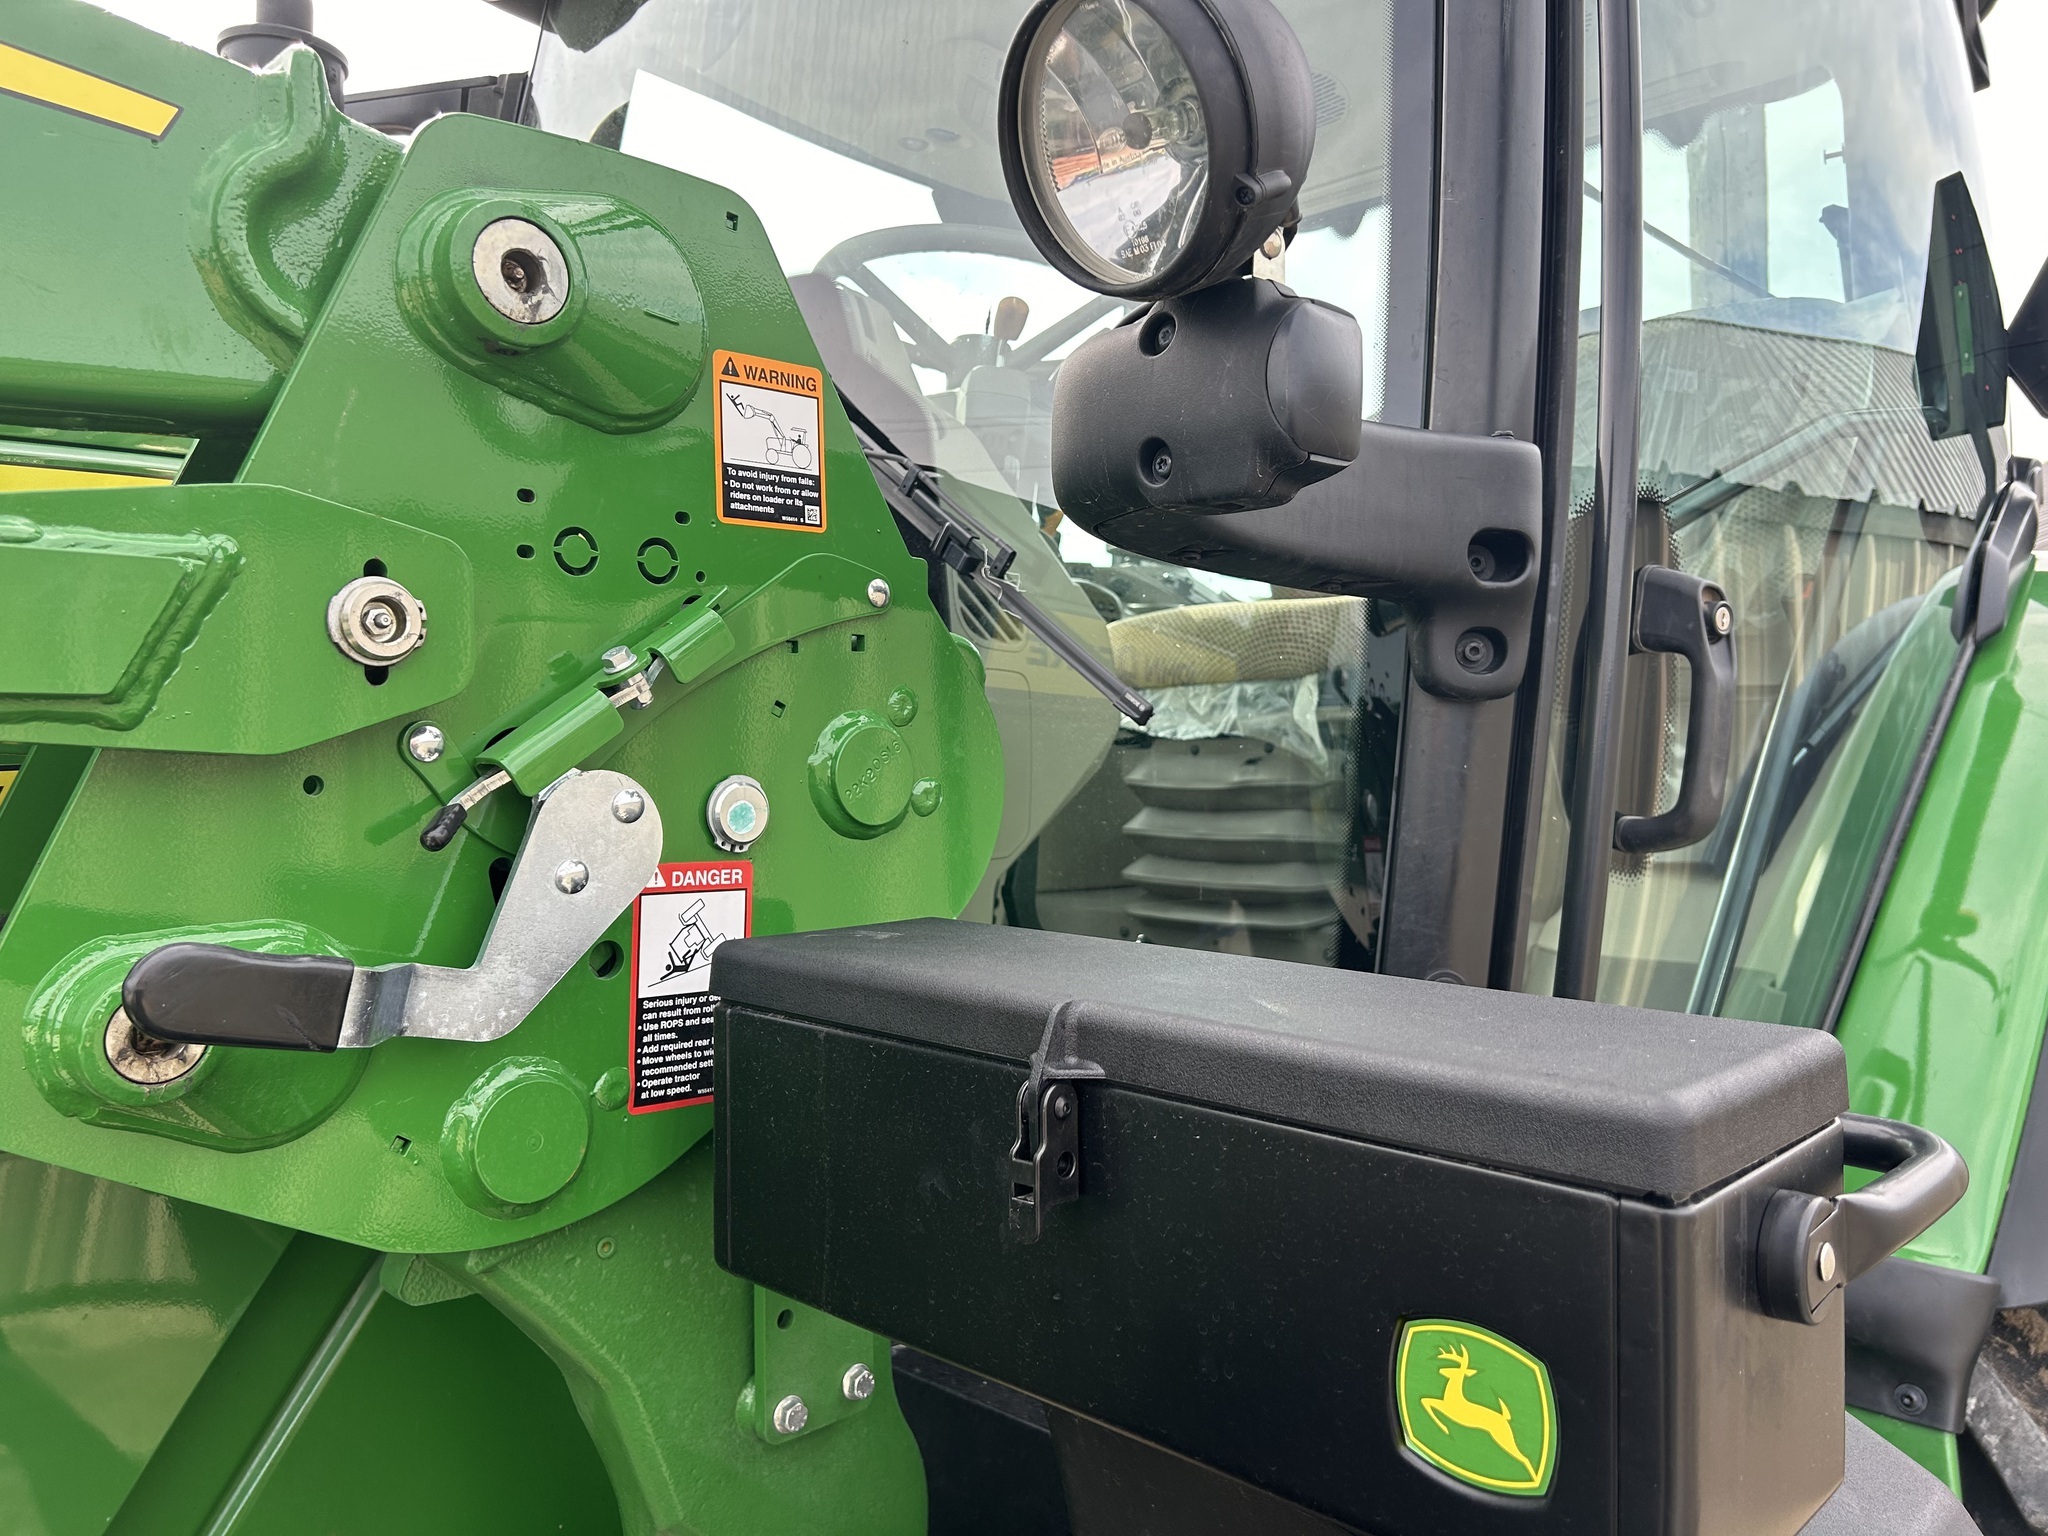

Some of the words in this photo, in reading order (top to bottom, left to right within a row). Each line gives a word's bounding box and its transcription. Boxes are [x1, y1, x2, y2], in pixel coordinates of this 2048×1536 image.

[743, 364, 817, 392] WARNING
[727, 467, 736, 475] To
[738, 470, 757, 478] avoid
[759, 471, 779, 482] injury
[781, 475, 797, 484] from
[799, 477, 815, 486] falls:
[730, 480, 740, 488] Do
[742, 482, 754, 490] not
[756, 484, 773, 492] work
[775, 486, 790, 495] from
[801, 490, 819, 498] allow
[730, 491, 751, 500] riders
[763, 494, 784, 504] loader
[795, 498, 803, 506] its
[730, 502, 775, 513] attachments
[672, 869, 742, 886] DANGER
[643, 999, 673, 1009] Serious
[675, 996, 697, 1006] injury
[659, 1008, 681, 1018] result
[683, 1007, 701, 1015] from
[643, 1023, 659, 1031] Use
[661, 1019, 683, 1029] ROPS
[685, 1017, 699, 1025] and
[643, 1034, 652, 1043] all
[654, 1032, 678, 1041] times.
[642, 1044, 659, 1054] Add
[661, 1040, 693, 1052] required
[642, 1056, 664, 1065] Move
[665, 1051, 692, 1062] wheels
[694, 1050, 702, 1058] to
[642, 1061, 697, 1076] recommended
[641, 1076, 673, 1088] Operate
[675, 1073, 700, 1083] tractor
[641, 1091, 649, 1099] at
[651, 1089, 665, 1098] low
[667, 1084, 692, 1096] speed.
